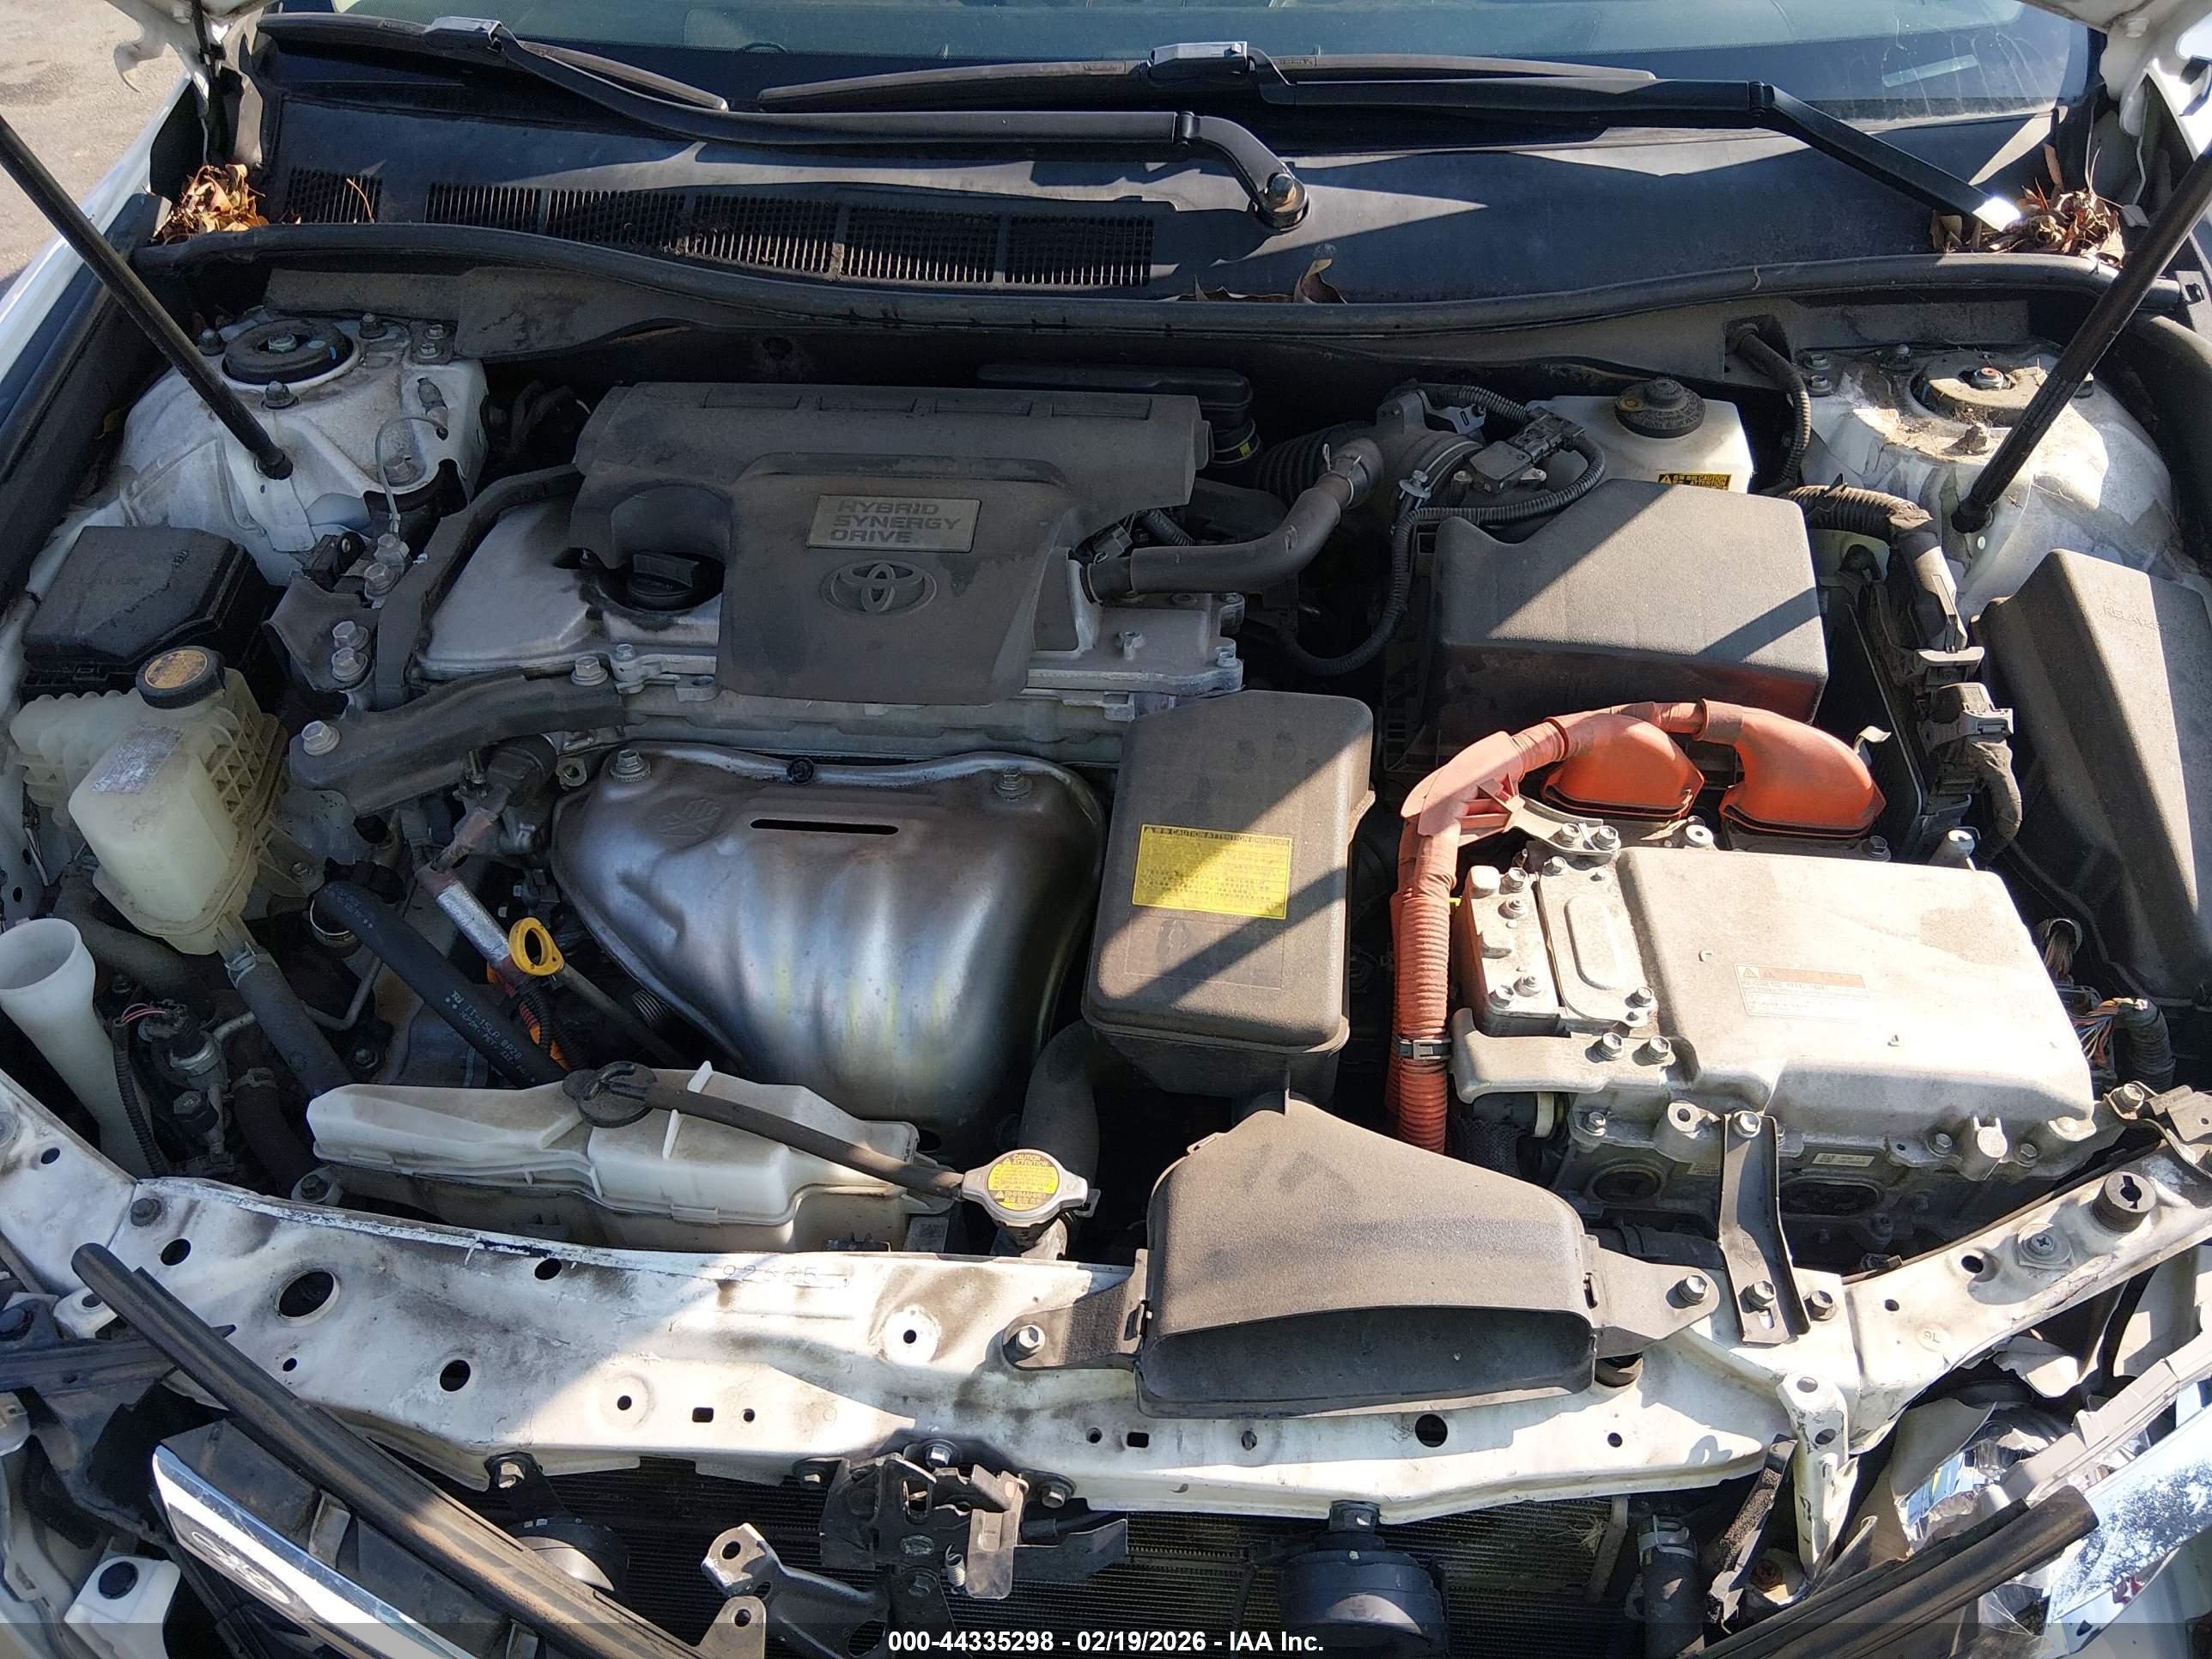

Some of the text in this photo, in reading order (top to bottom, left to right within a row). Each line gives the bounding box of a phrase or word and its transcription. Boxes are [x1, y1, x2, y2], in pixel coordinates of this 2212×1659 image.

[838, 501, 939, 515] HYBRID
[833, 515, 962, 530] SYNERGY
[830, 530, 914, 544] DRIVE
[1171, 830, 1206, 838] CAUTION
[1206, 833, 1249, 842] ATTENTION
